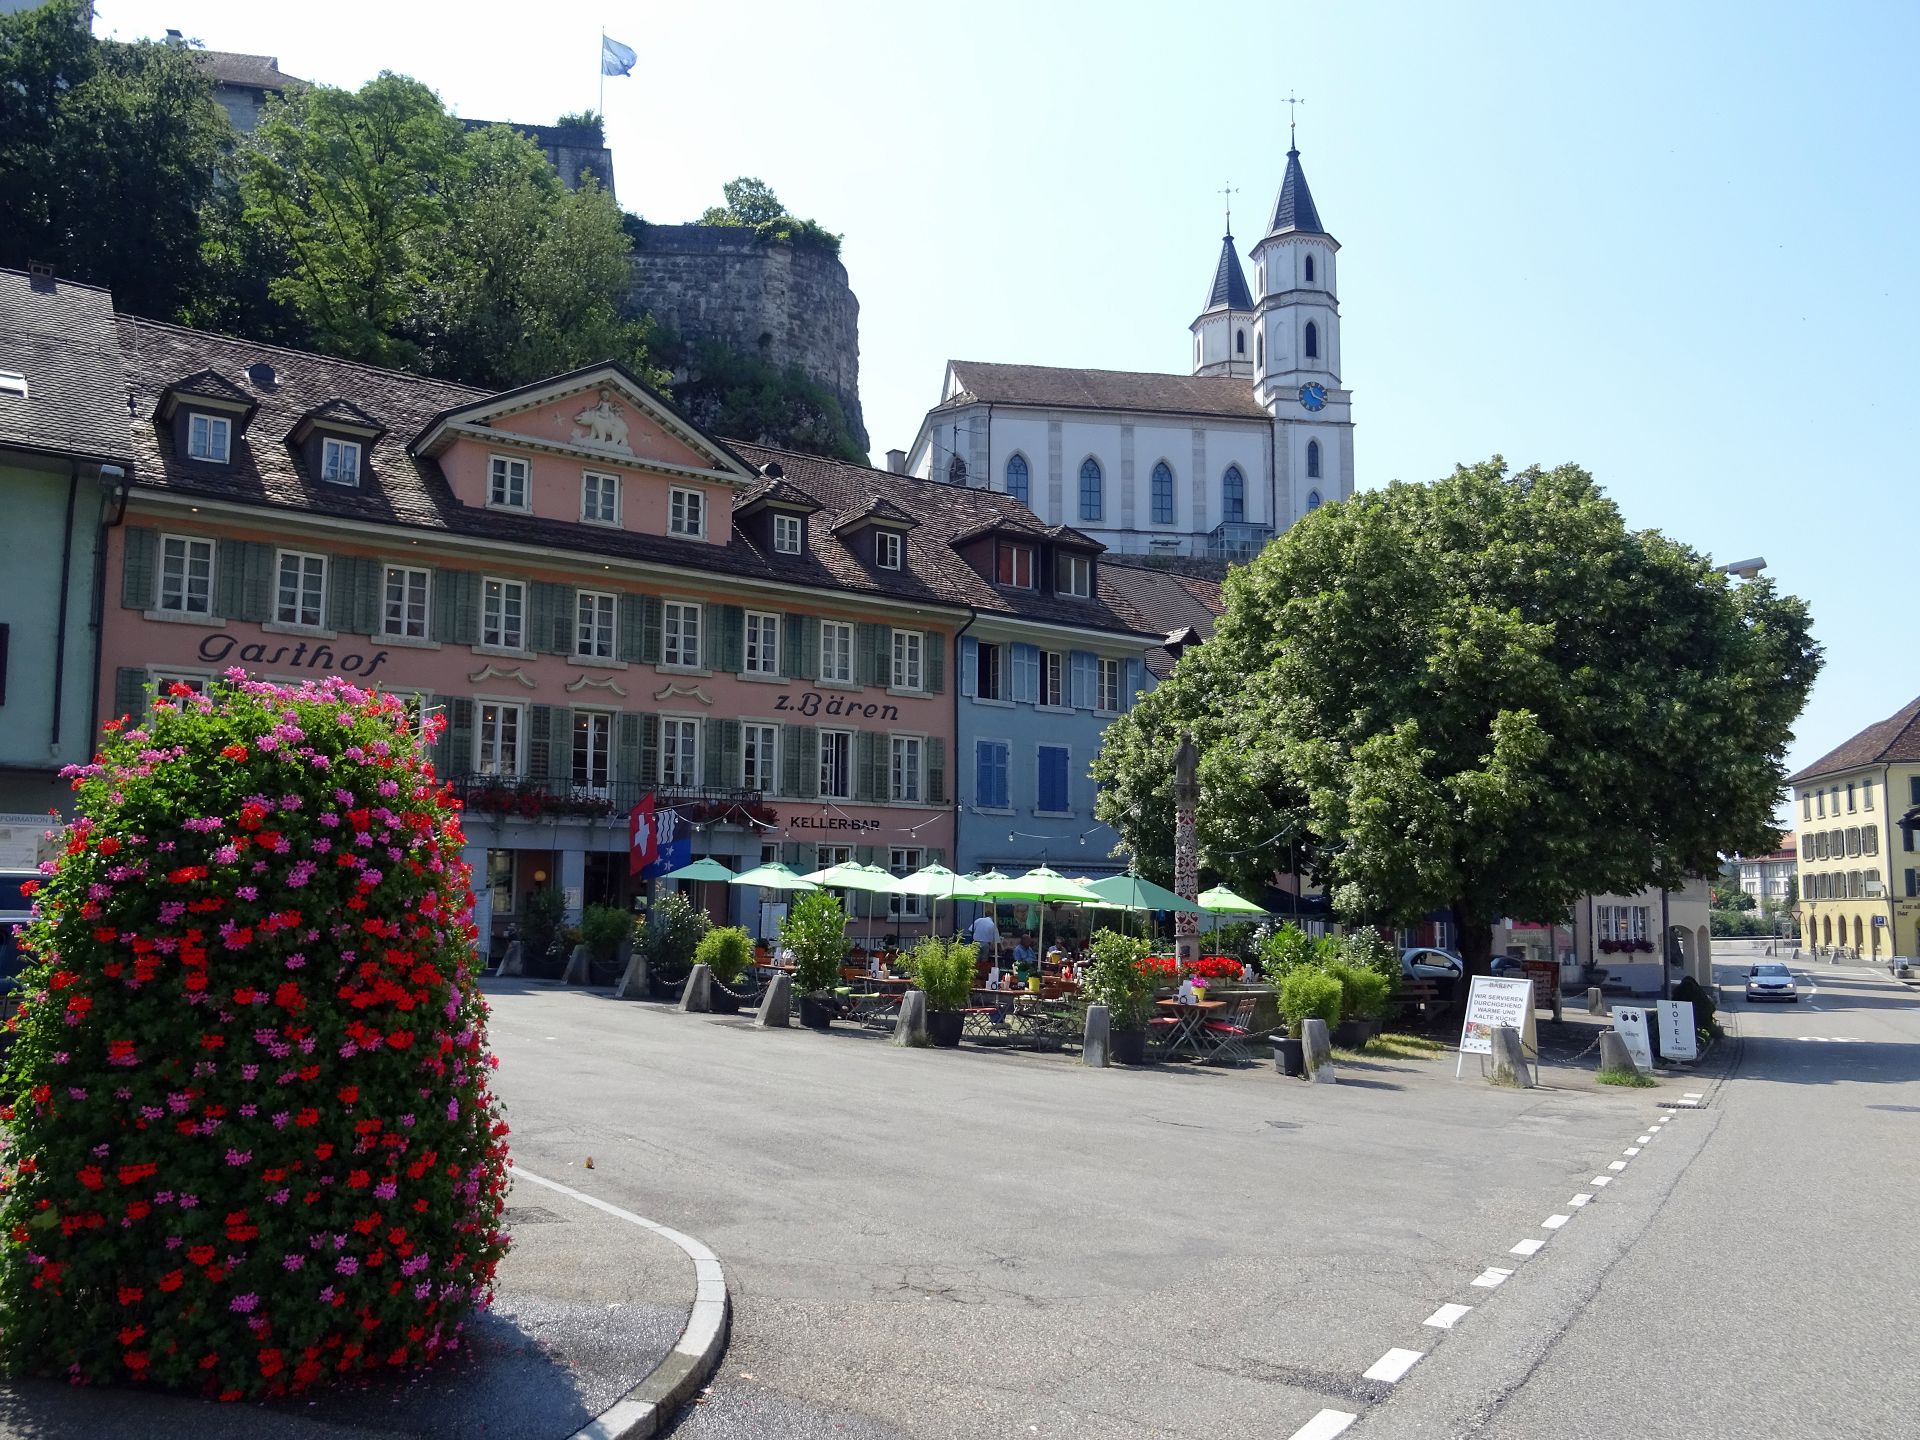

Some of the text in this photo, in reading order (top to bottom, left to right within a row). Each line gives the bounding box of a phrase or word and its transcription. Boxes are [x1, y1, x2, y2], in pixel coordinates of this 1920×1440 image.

[197, 633, 389, 677] Gasthof
[790, 816, 880, 831] KELLER-BAR
[1474, 1000, 1522, 1008] DURCHGEHEND
[1672, 1003, 1680, 1044] HOTEL
